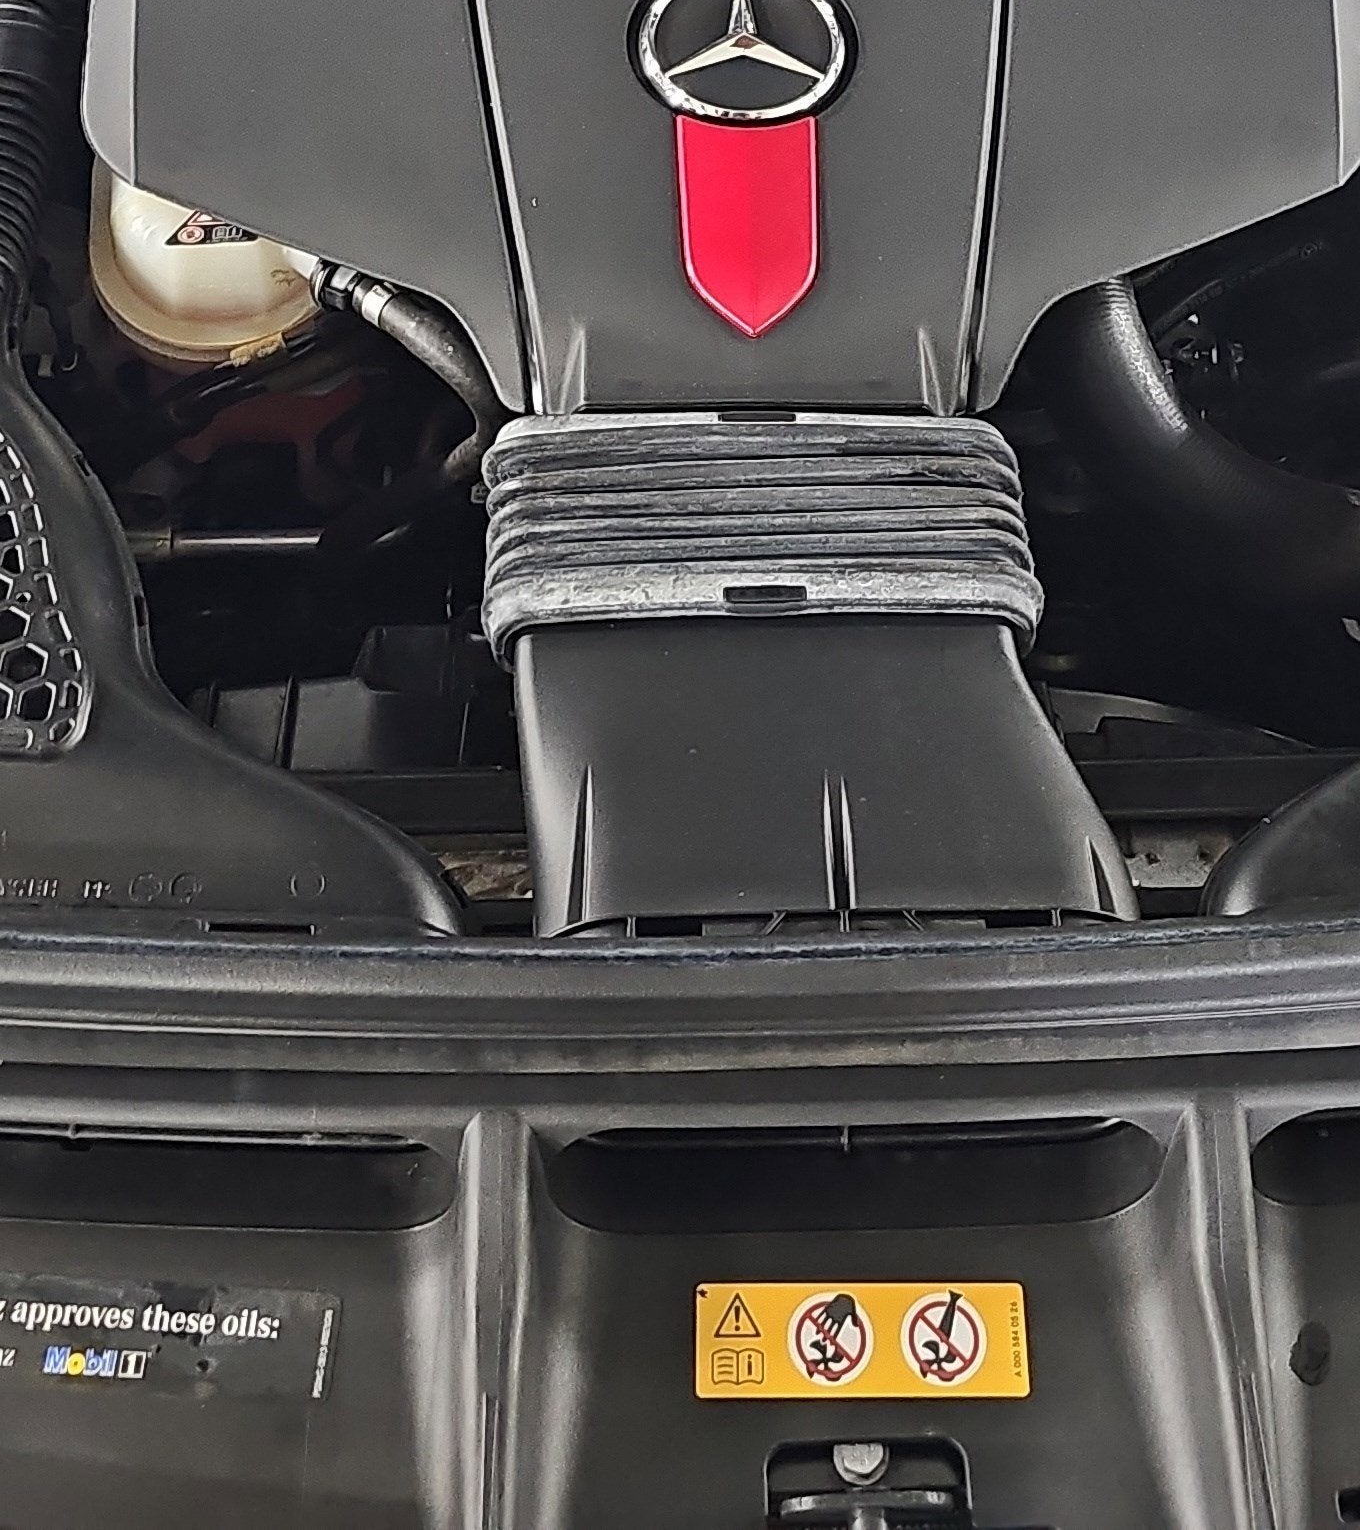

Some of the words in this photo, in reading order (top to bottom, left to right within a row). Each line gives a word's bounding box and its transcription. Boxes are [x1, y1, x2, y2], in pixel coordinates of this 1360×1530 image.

[11, 1299, 134, 1332] approves
[141, 1303, 215, 1335] these
[221, 1311, 280, 1339] oils:
[43, 1344, 116, 1377] Mobil
